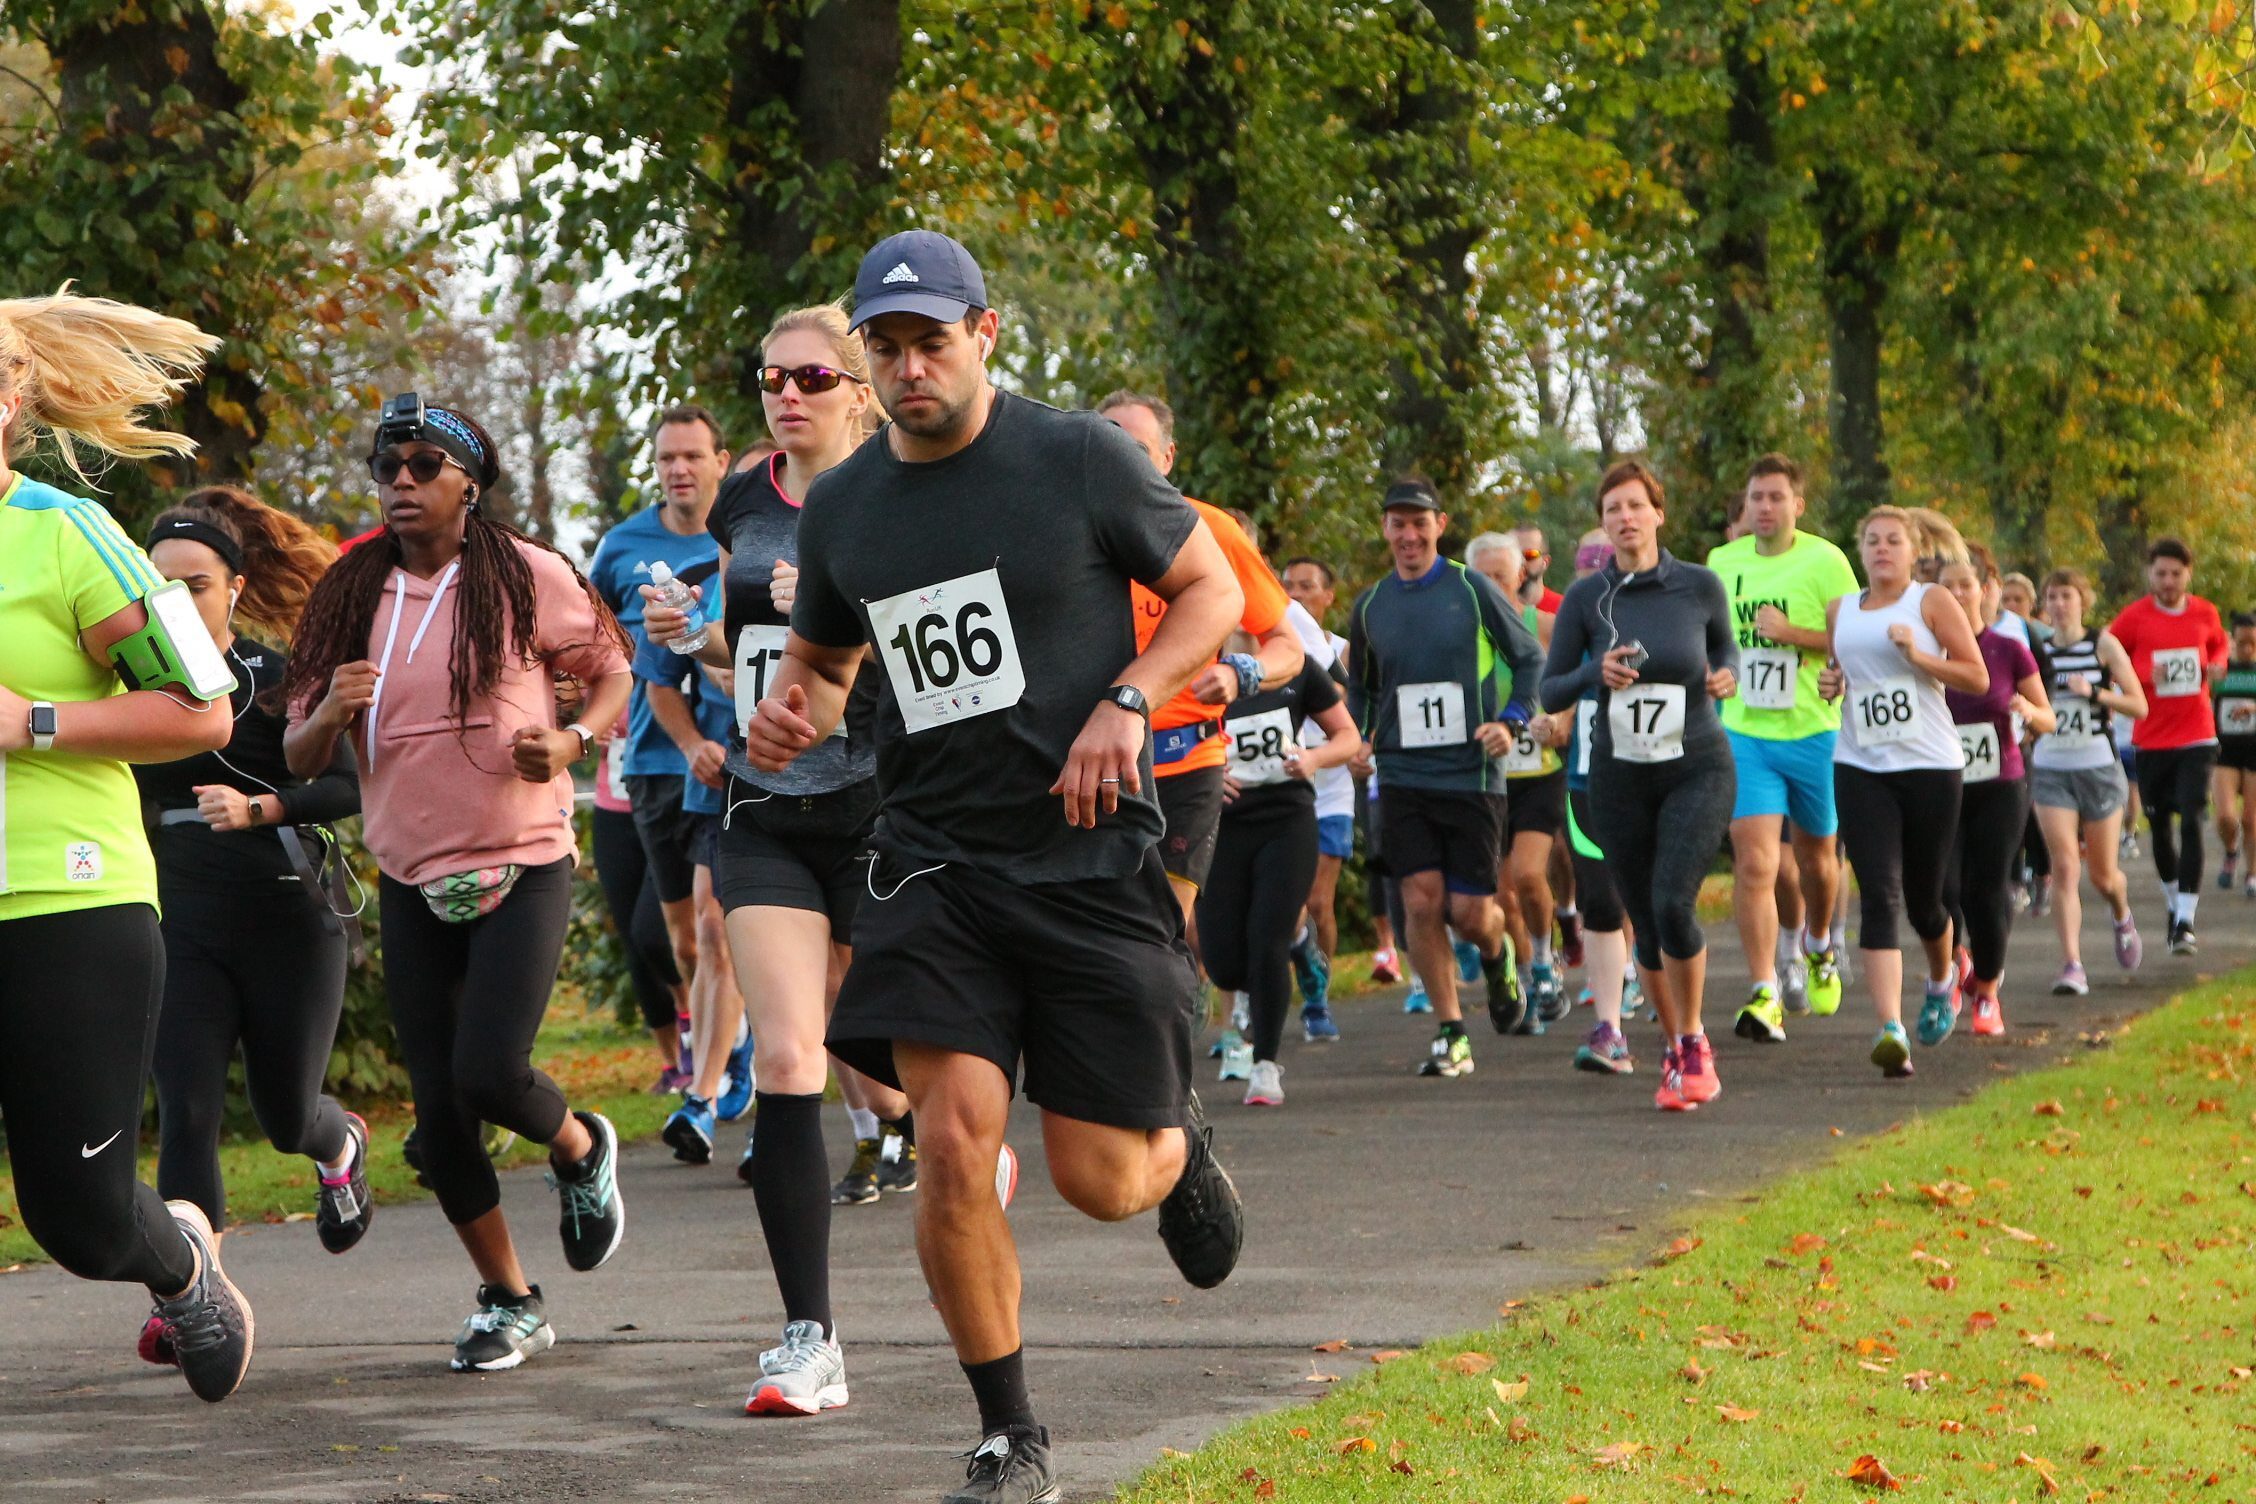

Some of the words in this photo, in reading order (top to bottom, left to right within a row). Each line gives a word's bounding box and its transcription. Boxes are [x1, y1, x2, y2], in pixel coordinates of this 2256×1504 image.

[882, 273, 920, 285] adidas
[890, 601, 1003, 693] 166
[1747, 660, 1788, 691] 171
[1418, 696, 1445, 729] 11
[1627, 697, 1667, 734] 17
[1858, 689, 1912, 728] 168
